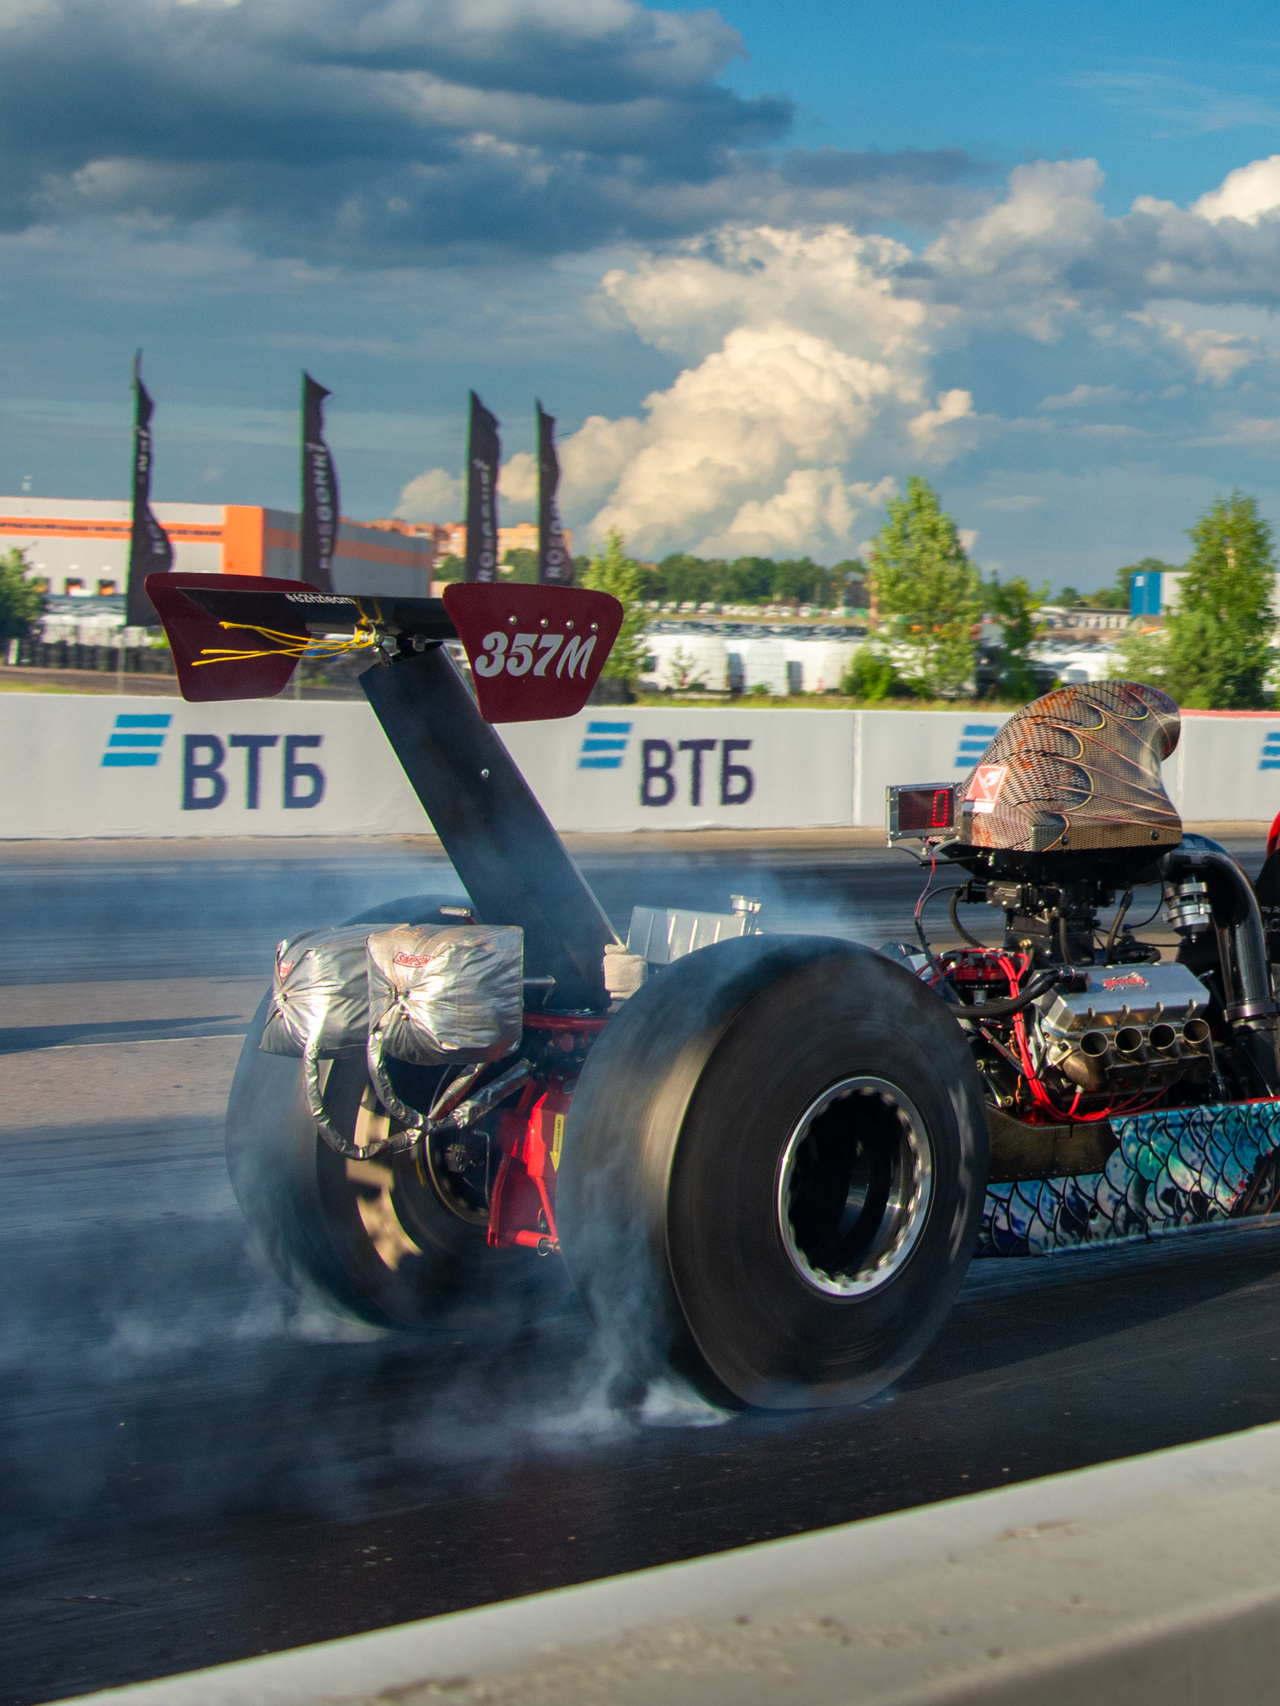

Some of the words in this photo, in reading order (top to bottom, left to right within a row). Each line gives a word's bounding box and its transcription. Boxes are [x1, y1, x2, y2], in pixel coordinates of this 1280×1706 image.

[475, 631, 597, 679] 357M
[181, 734, 327, 810] ВТБ
[640, 739, 756, 806] ВТБ
